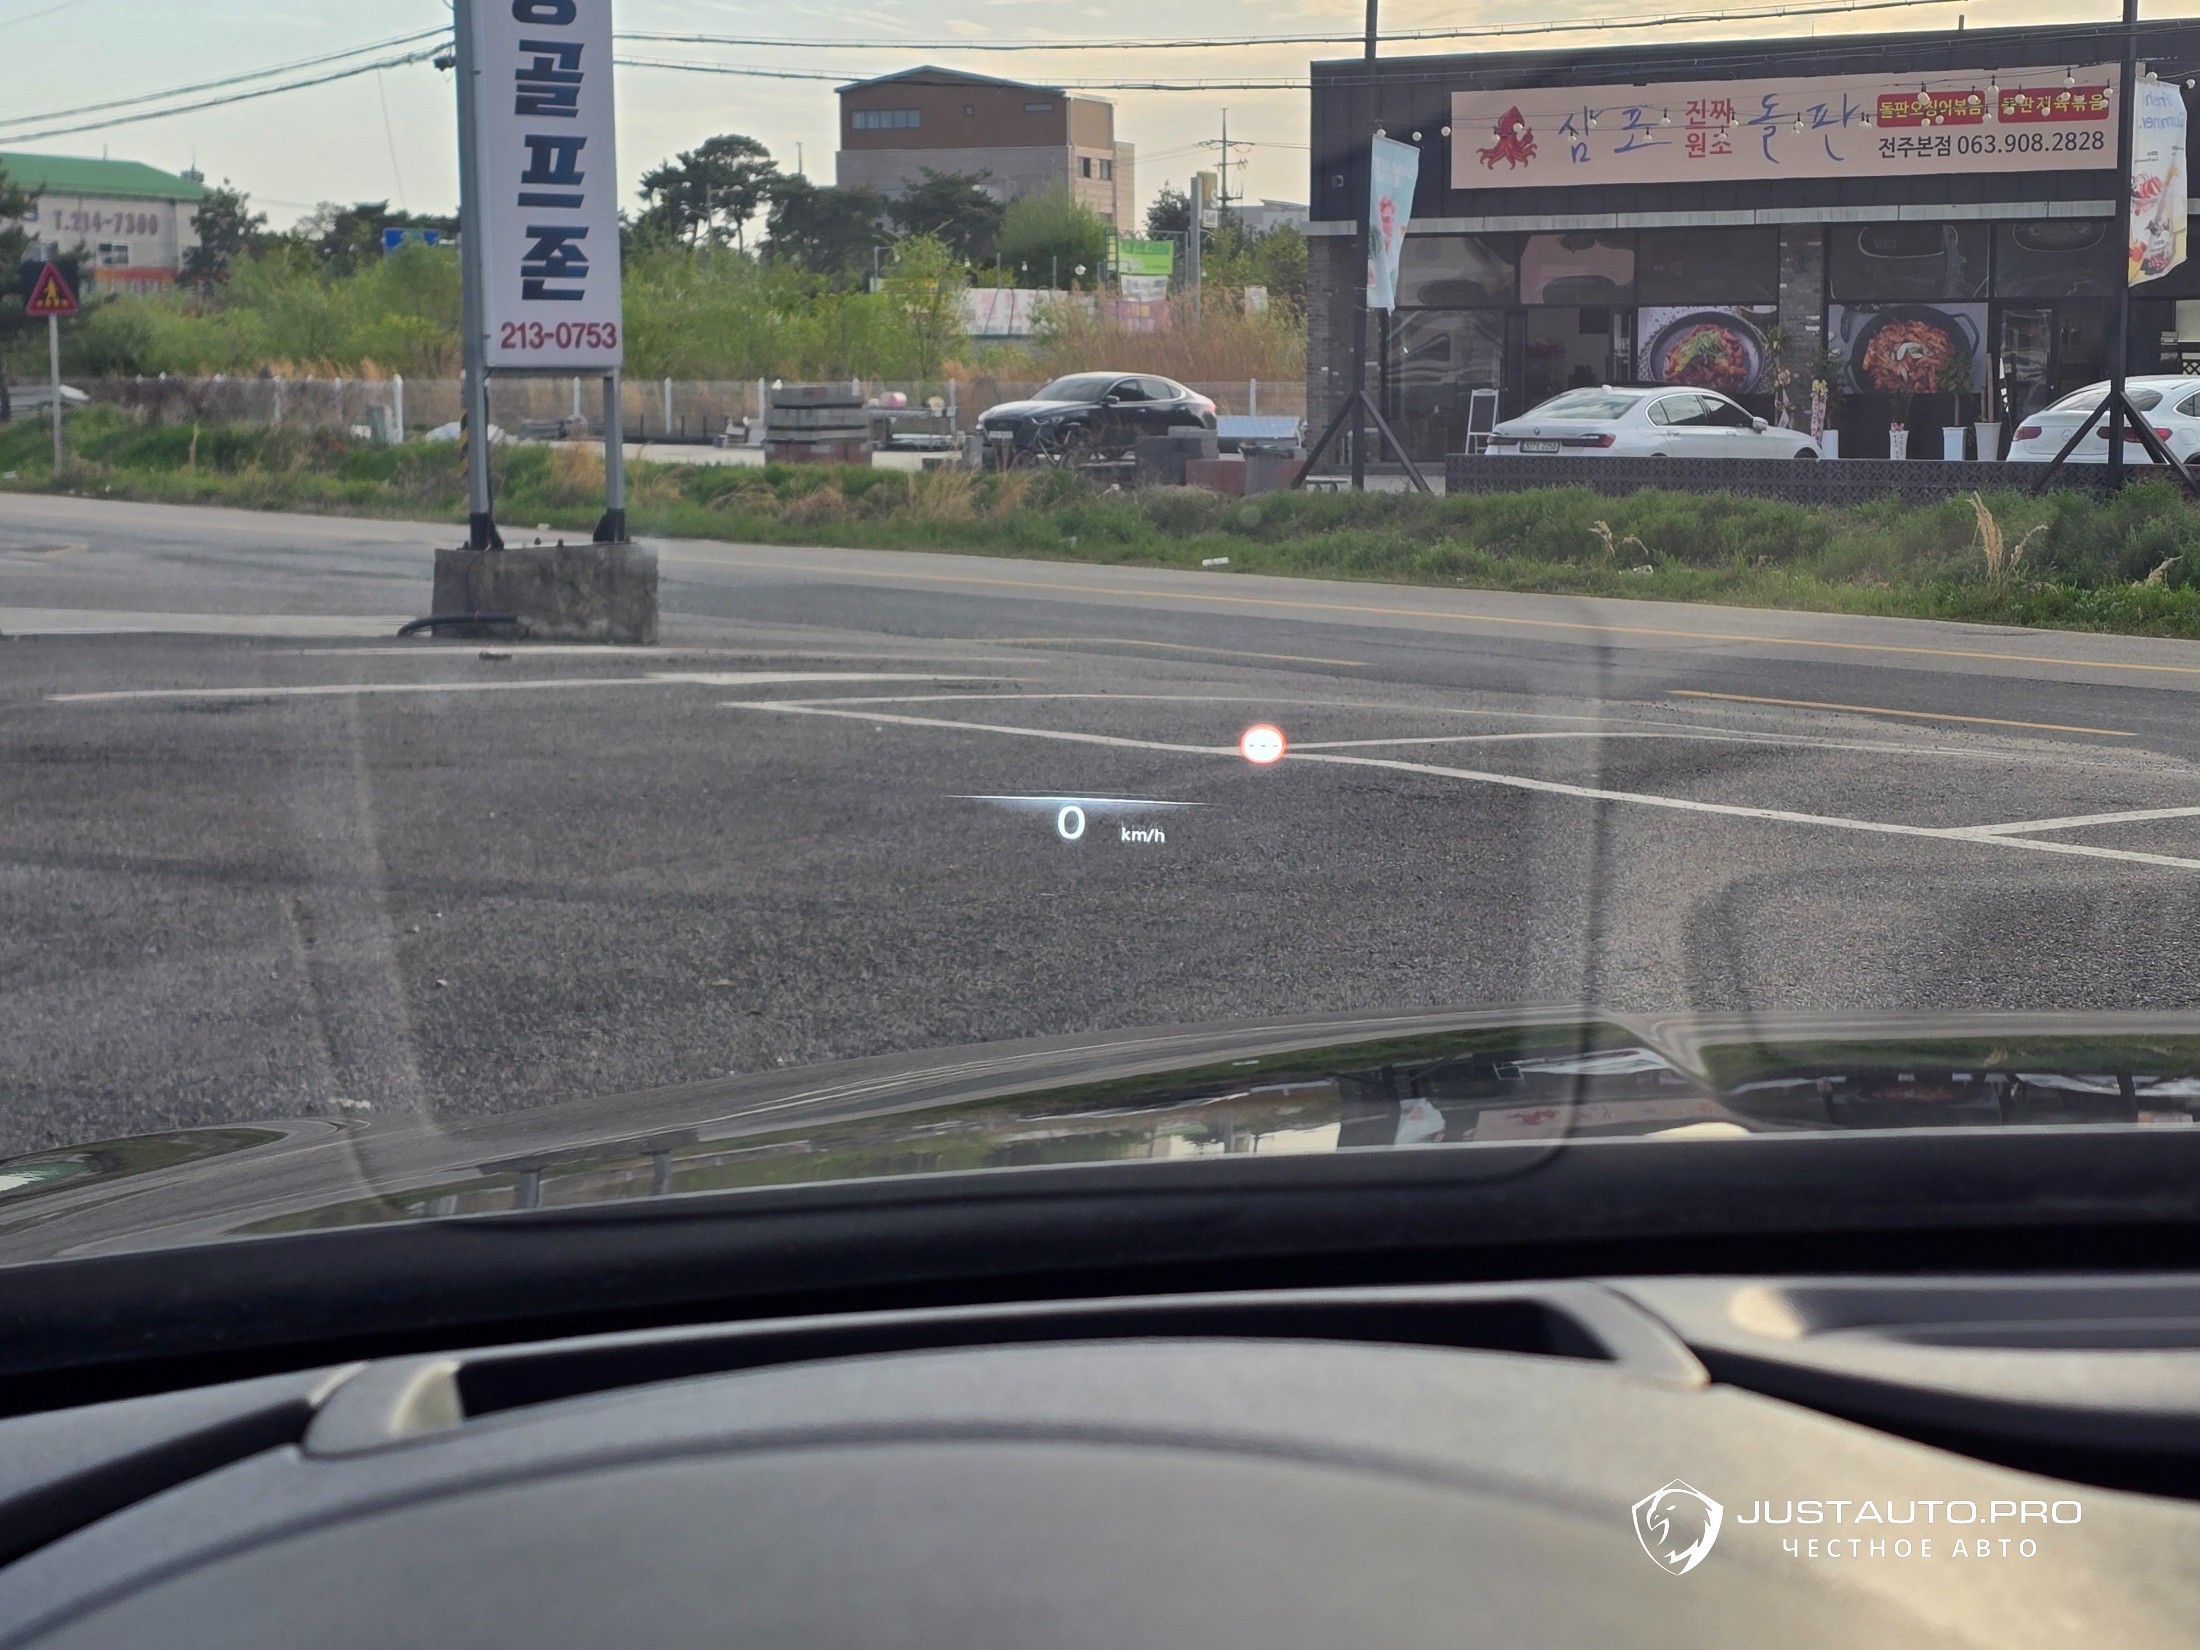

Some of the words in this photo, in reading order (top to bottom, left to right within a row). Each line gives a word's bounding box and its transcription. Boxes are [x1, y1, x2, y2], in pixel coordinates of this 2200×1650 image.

[1685, 98, 1731, 125] 진짜
[1879, 134, 1951, 159] 전주본점
[1957, 130, 2105, 155] 063.908.2828
[500, 321, 618, 350] 213-0753
[1057, 805, 1086, 839] 0
[1121, 826, 1166, 843] km/h
